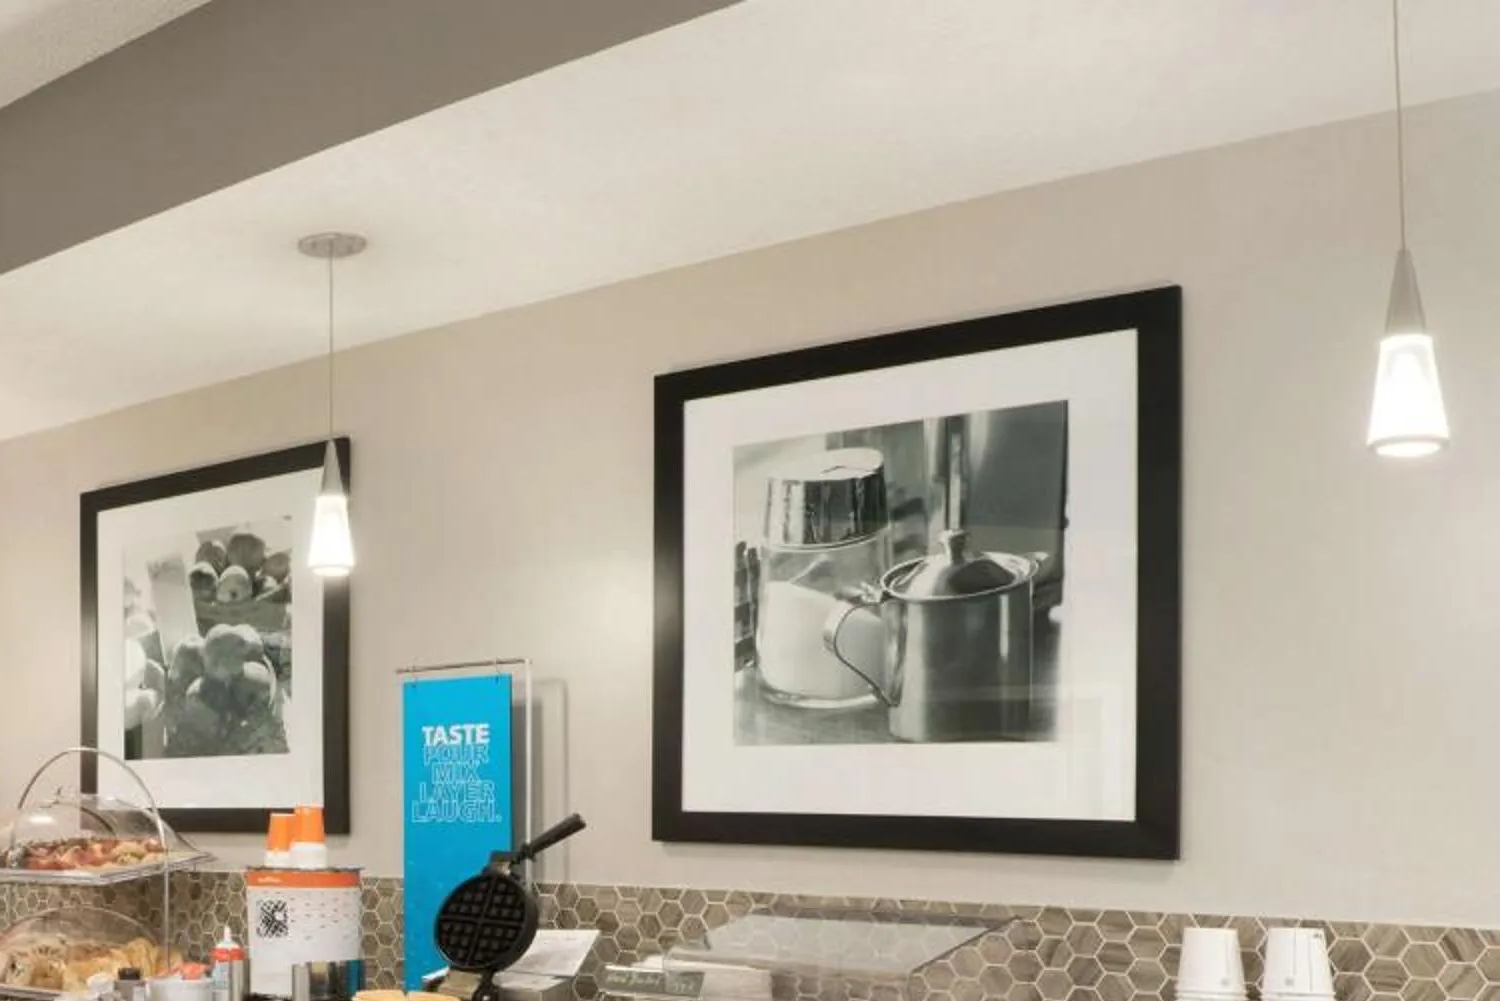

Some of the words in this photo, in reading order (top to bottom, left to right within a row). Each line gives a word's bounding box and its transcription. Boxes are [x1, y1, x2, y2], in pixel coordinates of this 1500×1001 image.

[421, 723, 491, 746] TASTE
[423, 744, 489, 766] POUR
[431, 761, 481, 784] MIX
[419, 781, 495, 802] LAYER
[411, 800, 502, 823] LAUGH.
